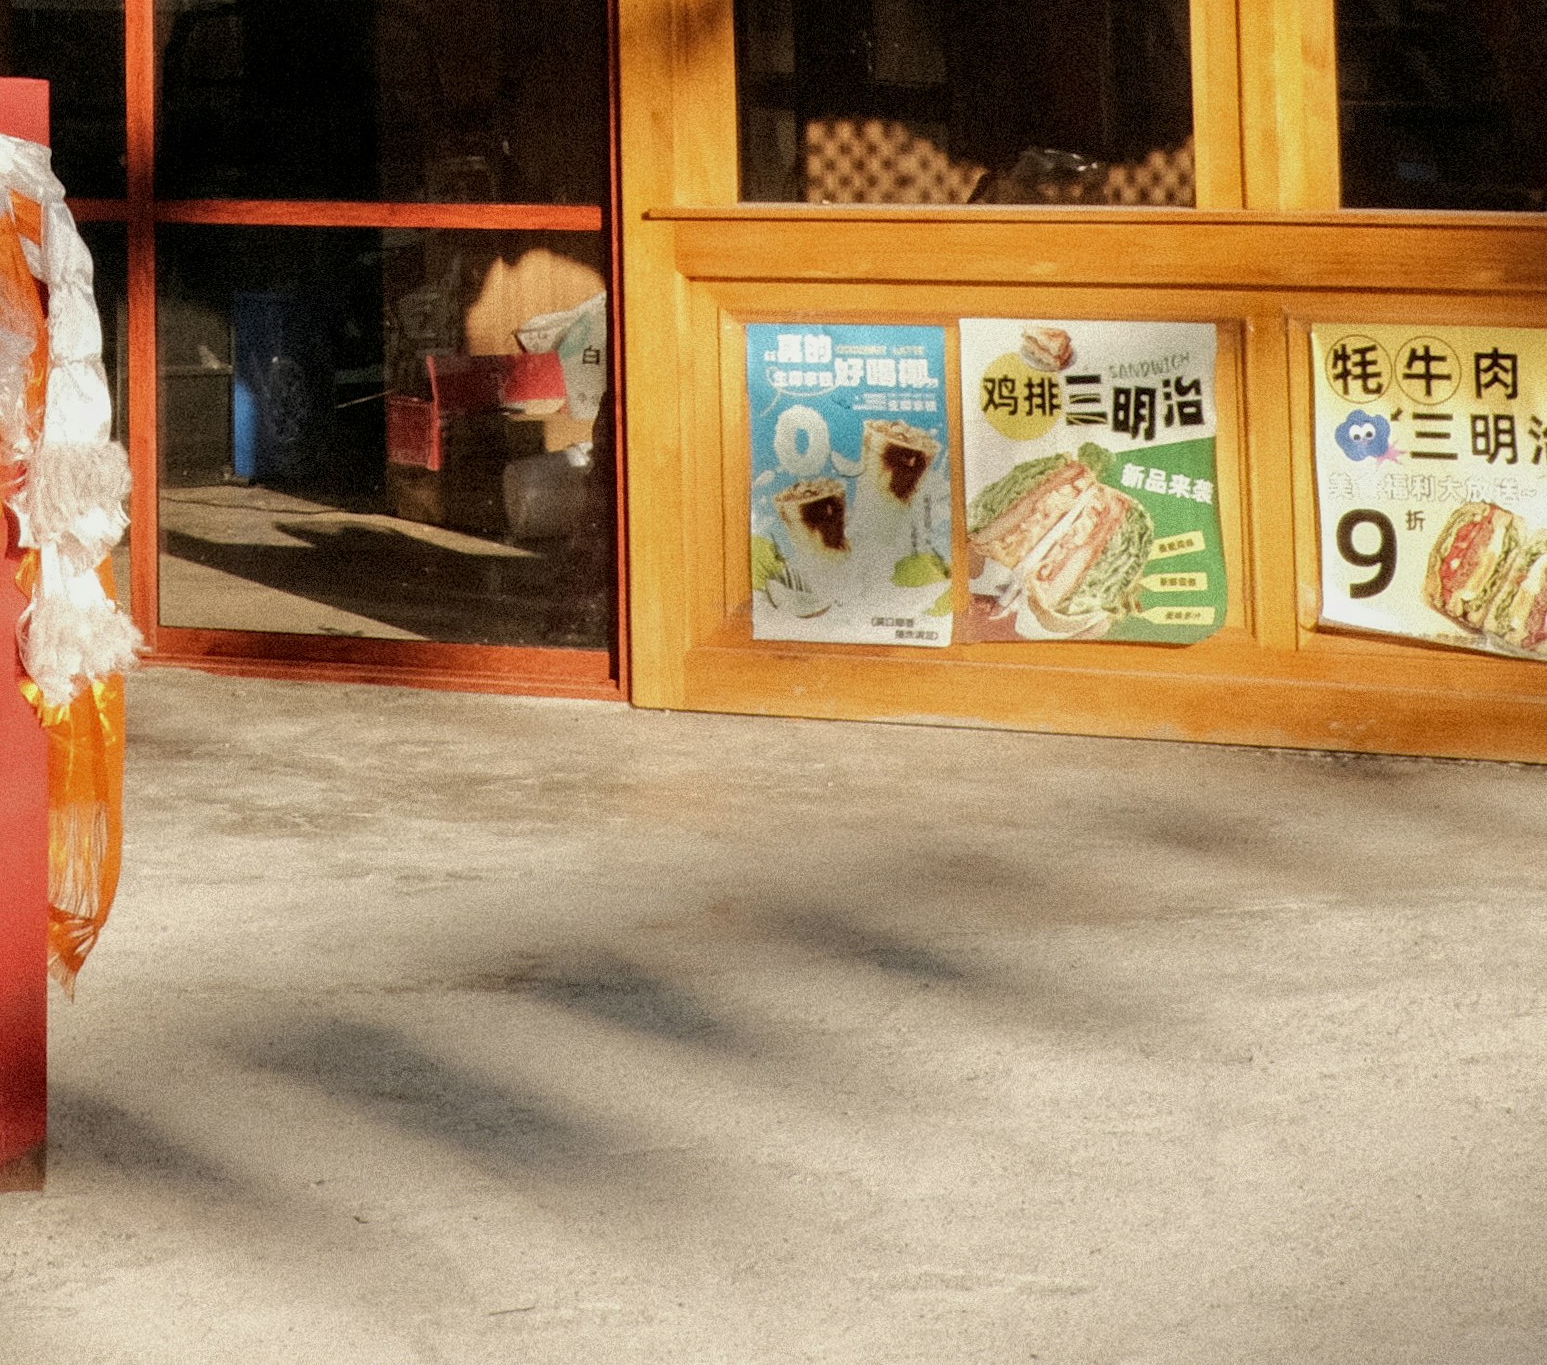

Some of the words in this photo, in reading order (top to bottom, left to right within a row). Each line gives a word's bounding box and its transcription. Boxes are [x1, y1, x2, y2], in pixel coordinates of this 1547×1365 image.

[582, 344, 600, 365] 白
[1331, 342, 1520, 402] 牦牛肉
[1121, 463, 1215, 505] 新品来袭
